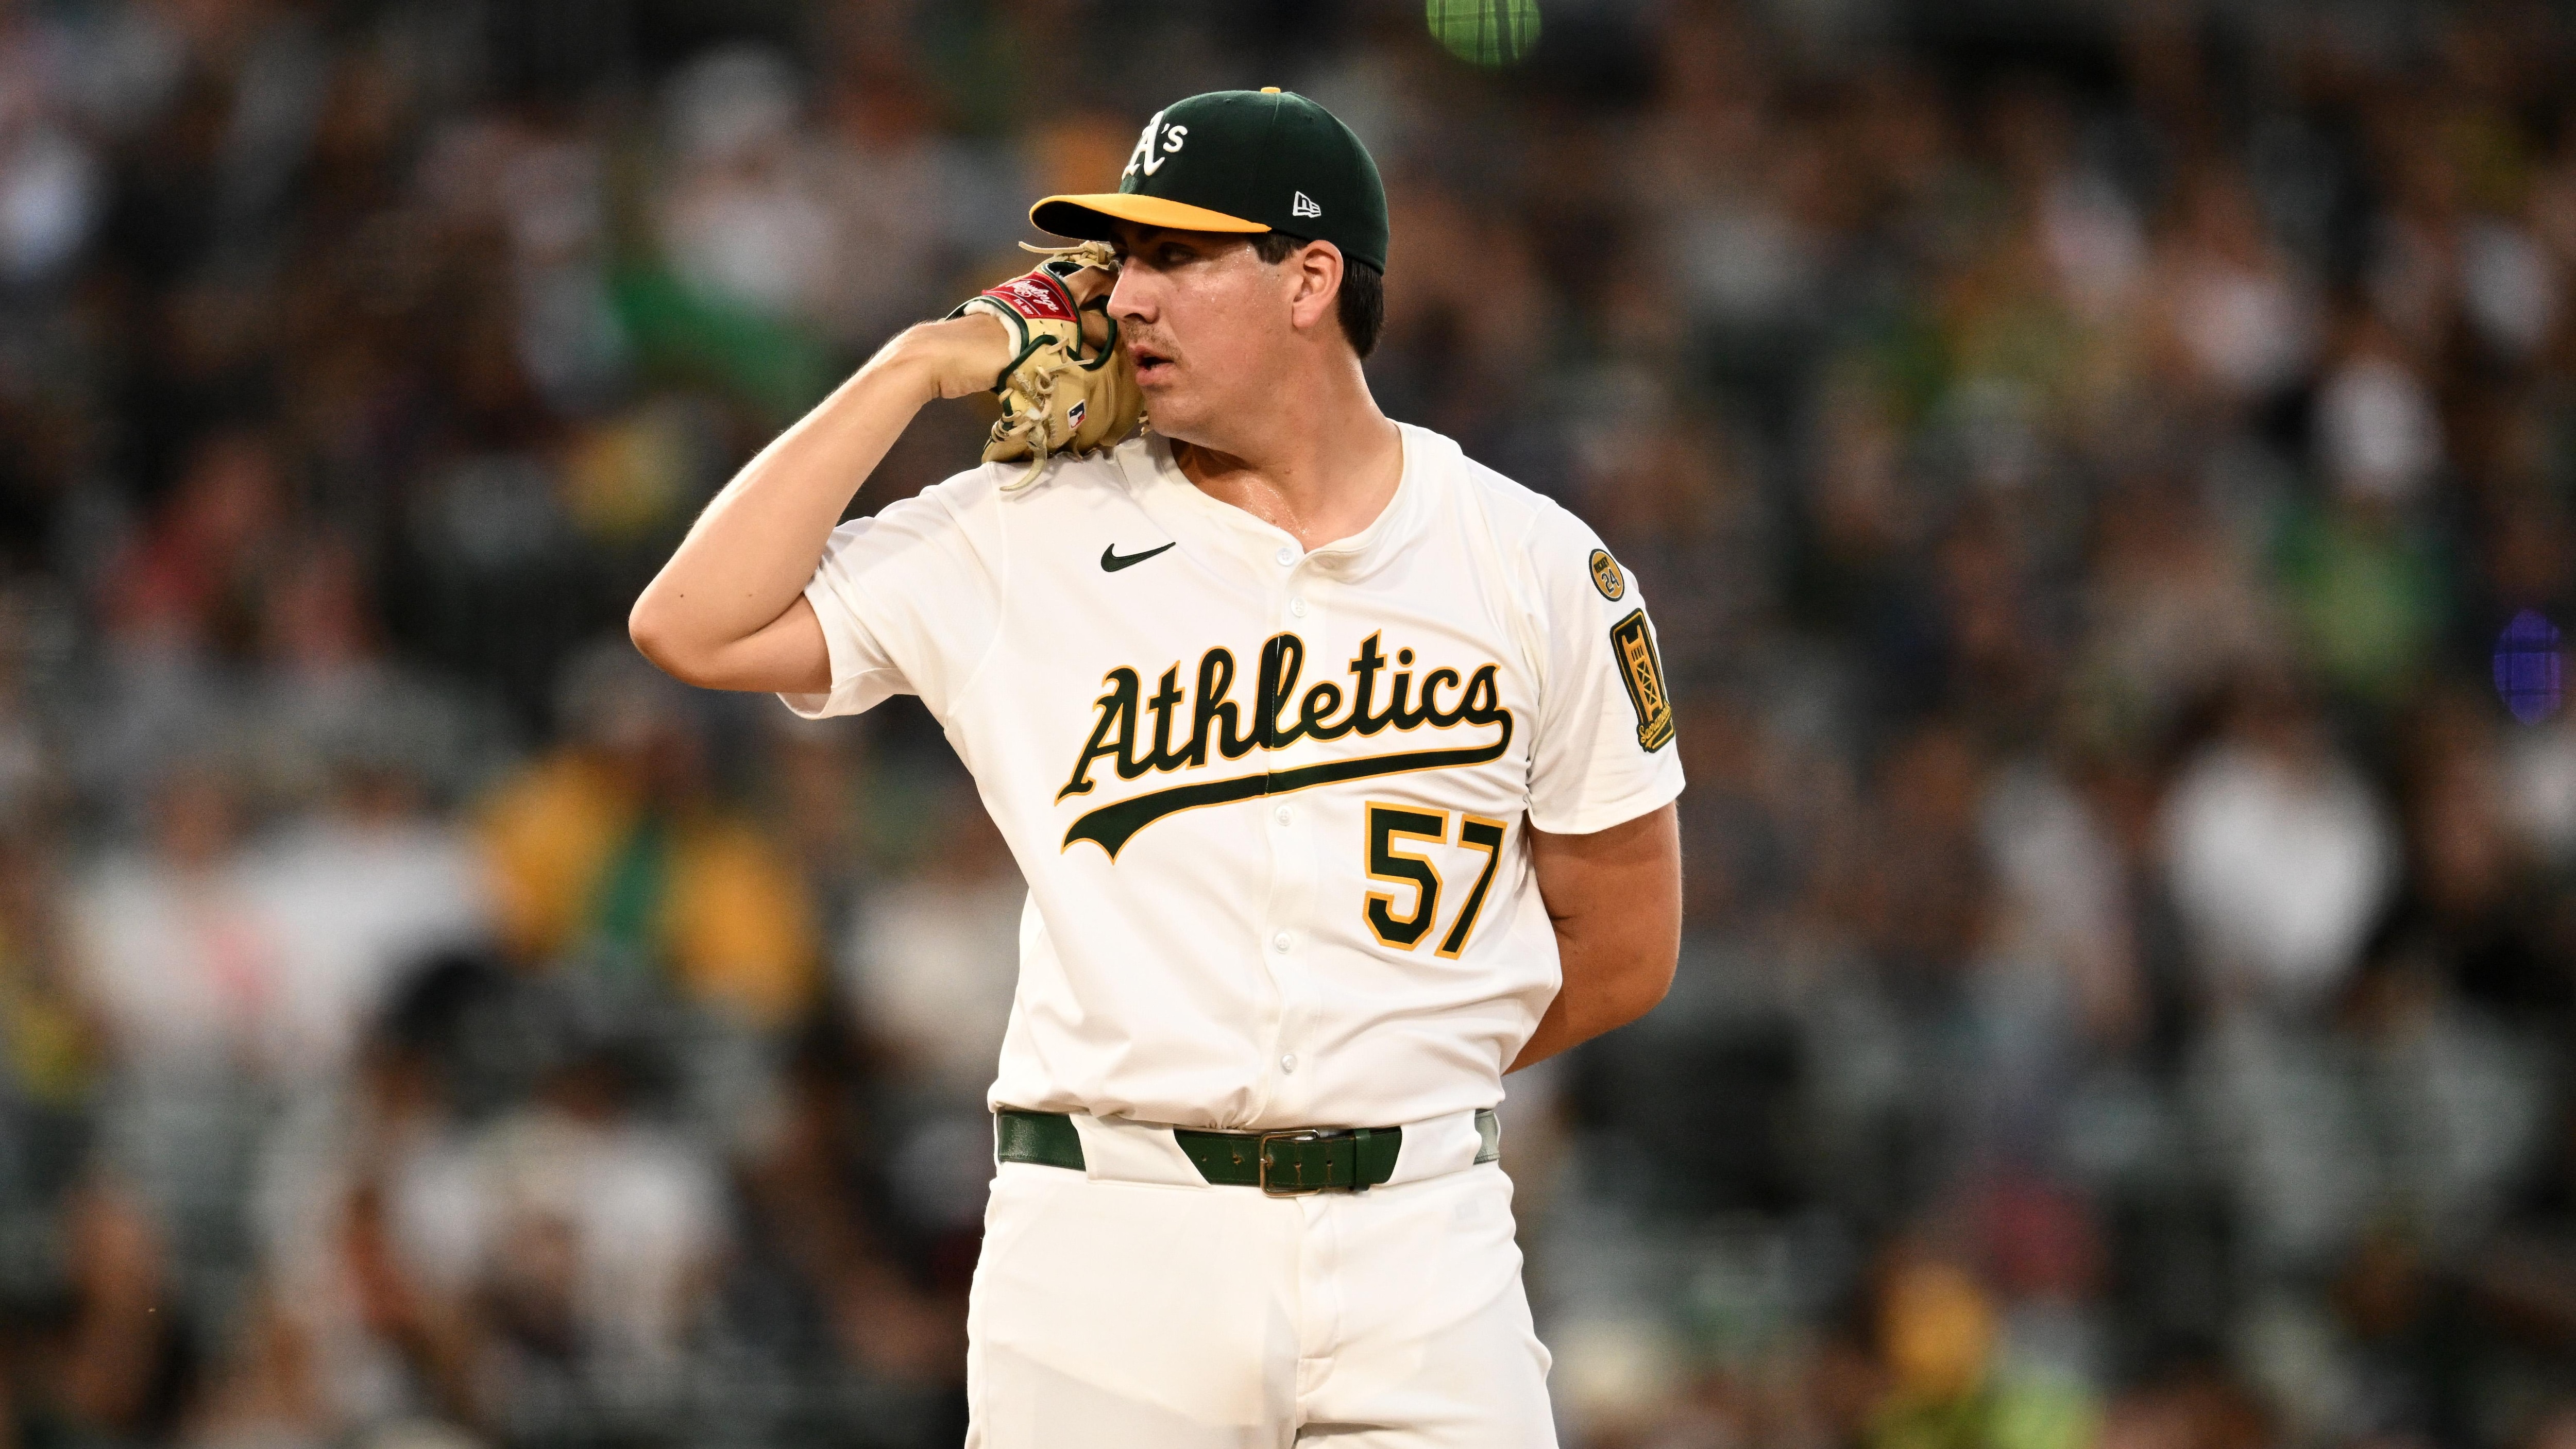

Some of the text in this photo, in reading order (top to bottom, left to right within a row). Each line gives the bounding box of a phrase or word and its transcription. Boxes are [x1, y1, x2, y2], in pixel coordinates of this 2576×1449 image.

[1122, 110, 1188, 180] A's
[1601, 567, 1620, 593] 24
[1054, 628, 1513, 807] Athletics
[1363, 800, 1509, 960] 57
